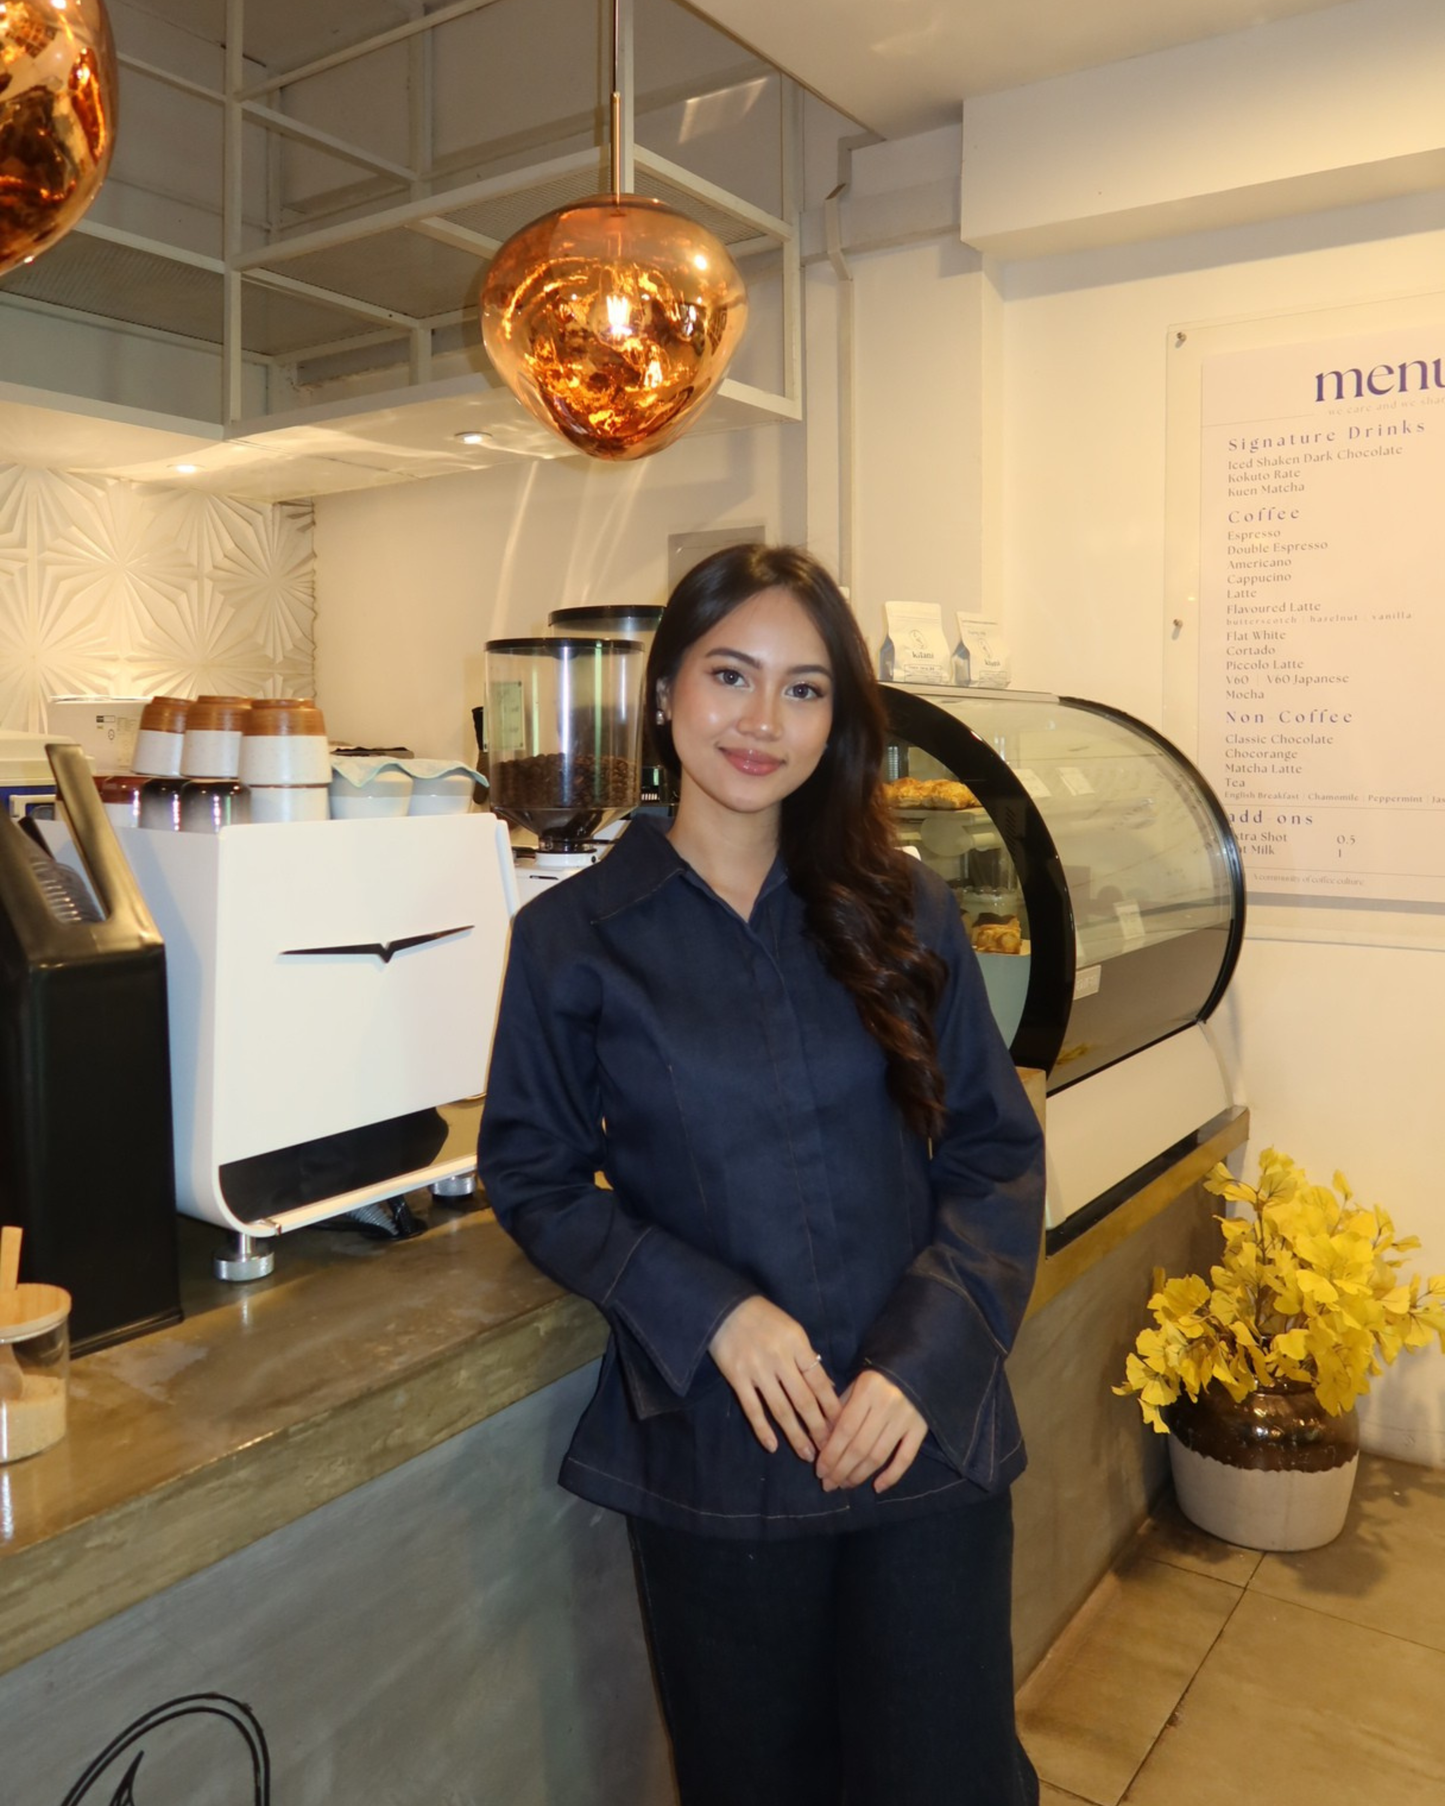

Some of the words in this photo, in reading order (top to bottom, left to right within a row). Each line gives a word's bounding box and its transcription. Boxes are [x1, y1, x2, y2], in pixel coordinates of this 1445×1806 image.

[1228, 430, 1336, 453] Signature
[1349, 420, 1426, 440] Drinks
[1228, 458, 1253, 470] Iced
[1256, 455, 1300, 467] Shaken
[1303, 451, 1333, 463] Dark
[1337, 445, 1403, 460] Chocolate
[1228, 472, 1270, 483] Kokuto
[1274, 469, 1301, 480] Rate
[1228, 487, 1258, 497] Kuen
[1261, 482, 1305, 494] Matcha
[1228, 506, 1300, 524] Coffee
[1227, 529, 1281, 542] Espresso
[1227, 543, 1270, 555] Double
[1273, 541, 1328, 554] Espresso
[1227, 558, 1292, 570] Americano
[1227, 572, 1292, 586] Cappucino
[1227, 589, 1257, 599] Latte
[1227, 602, 1286, 614] Flavoured
[1290, 602, 1321, 612] Latte
[1226, 616, 1297, 626] butterscotch
[1309, 614, 1358, 623] hazelnut
[1372, 611, 1412, 620] vanilla
[1226, 631, 1249, 641] Flat
[1252, 630, 1286, 640] White
[1226, 645, 1276, 656] Cortado
[1226, 659, 1269, 670] Piccolo
[1273, 659, 1304, 670] Latte
[1226, 674, 1250, 685] V60
[1266, 674, 1290, 684] V60
[1293, 674, 1350, 686] Japanese
[1226, 689, 1265, 700] Mocha
[1226, 711, 1264, 724] Non
[1279, 709, 1353, 723] Coffee
[1225, 734, 1267, 744] Classic
[1271, 734, 1334, 745] Chocolate
[1225, 748, 1298, 761] Chocorange
[1225, 763, 1268, 773] Matcha
[1271, 763, 1303, 774] Latte
[1225, 777, 1246, 788] Tea
[1224, 791, 1255, 800] English
[1258, 791, 1299, 800] Breakfast
[1307, 792, 1359, 801] Chamomile
[1368, 794, 1423, 803] Peppermint
[1229, 809, 1263, 823] add
[1276, 814, 1314, 825] ons
[1235, 832, 1257, 842] xtra
[1260, 831, 1287, 842] Shot
[1336, 834, 1356, 845] 0.5
[1251, 845, 1275, 855] Milk
